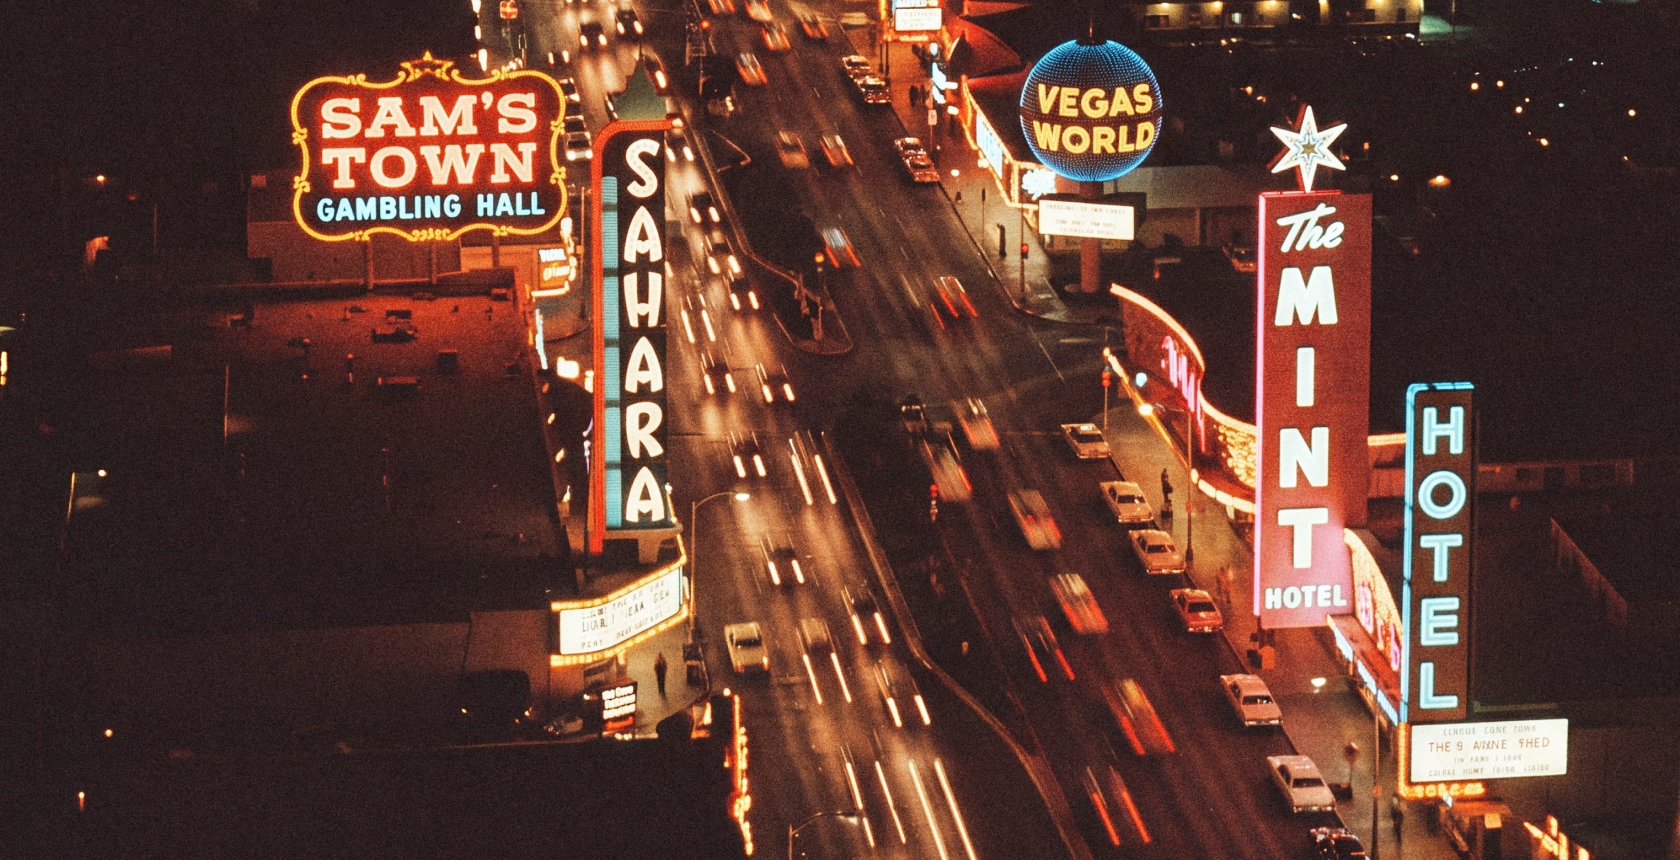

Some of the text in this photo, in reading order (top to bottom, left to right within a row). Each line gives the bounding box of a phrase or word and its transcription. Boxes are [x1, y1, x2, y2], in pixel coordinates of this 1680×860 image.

[321, 92, 538, 139] SAM'S
[1037, 83, 1153, 118] VEGAS
[1032, 120, 1156, 155] WORLD
[321, 142, 537, 188] TOWN
[316, 191, 546, 222] GAMBLING HALL
[1276, 202, 1345, 253] The
[623, 138, 665, 524] SAHARA
[1274, 265, 1339, 569] MINT
[1417, 406, 1467, 710] HOTEL
[1264, 584, 1347, 610] HOTEL
[1428, 741, 1451, 753] THE
